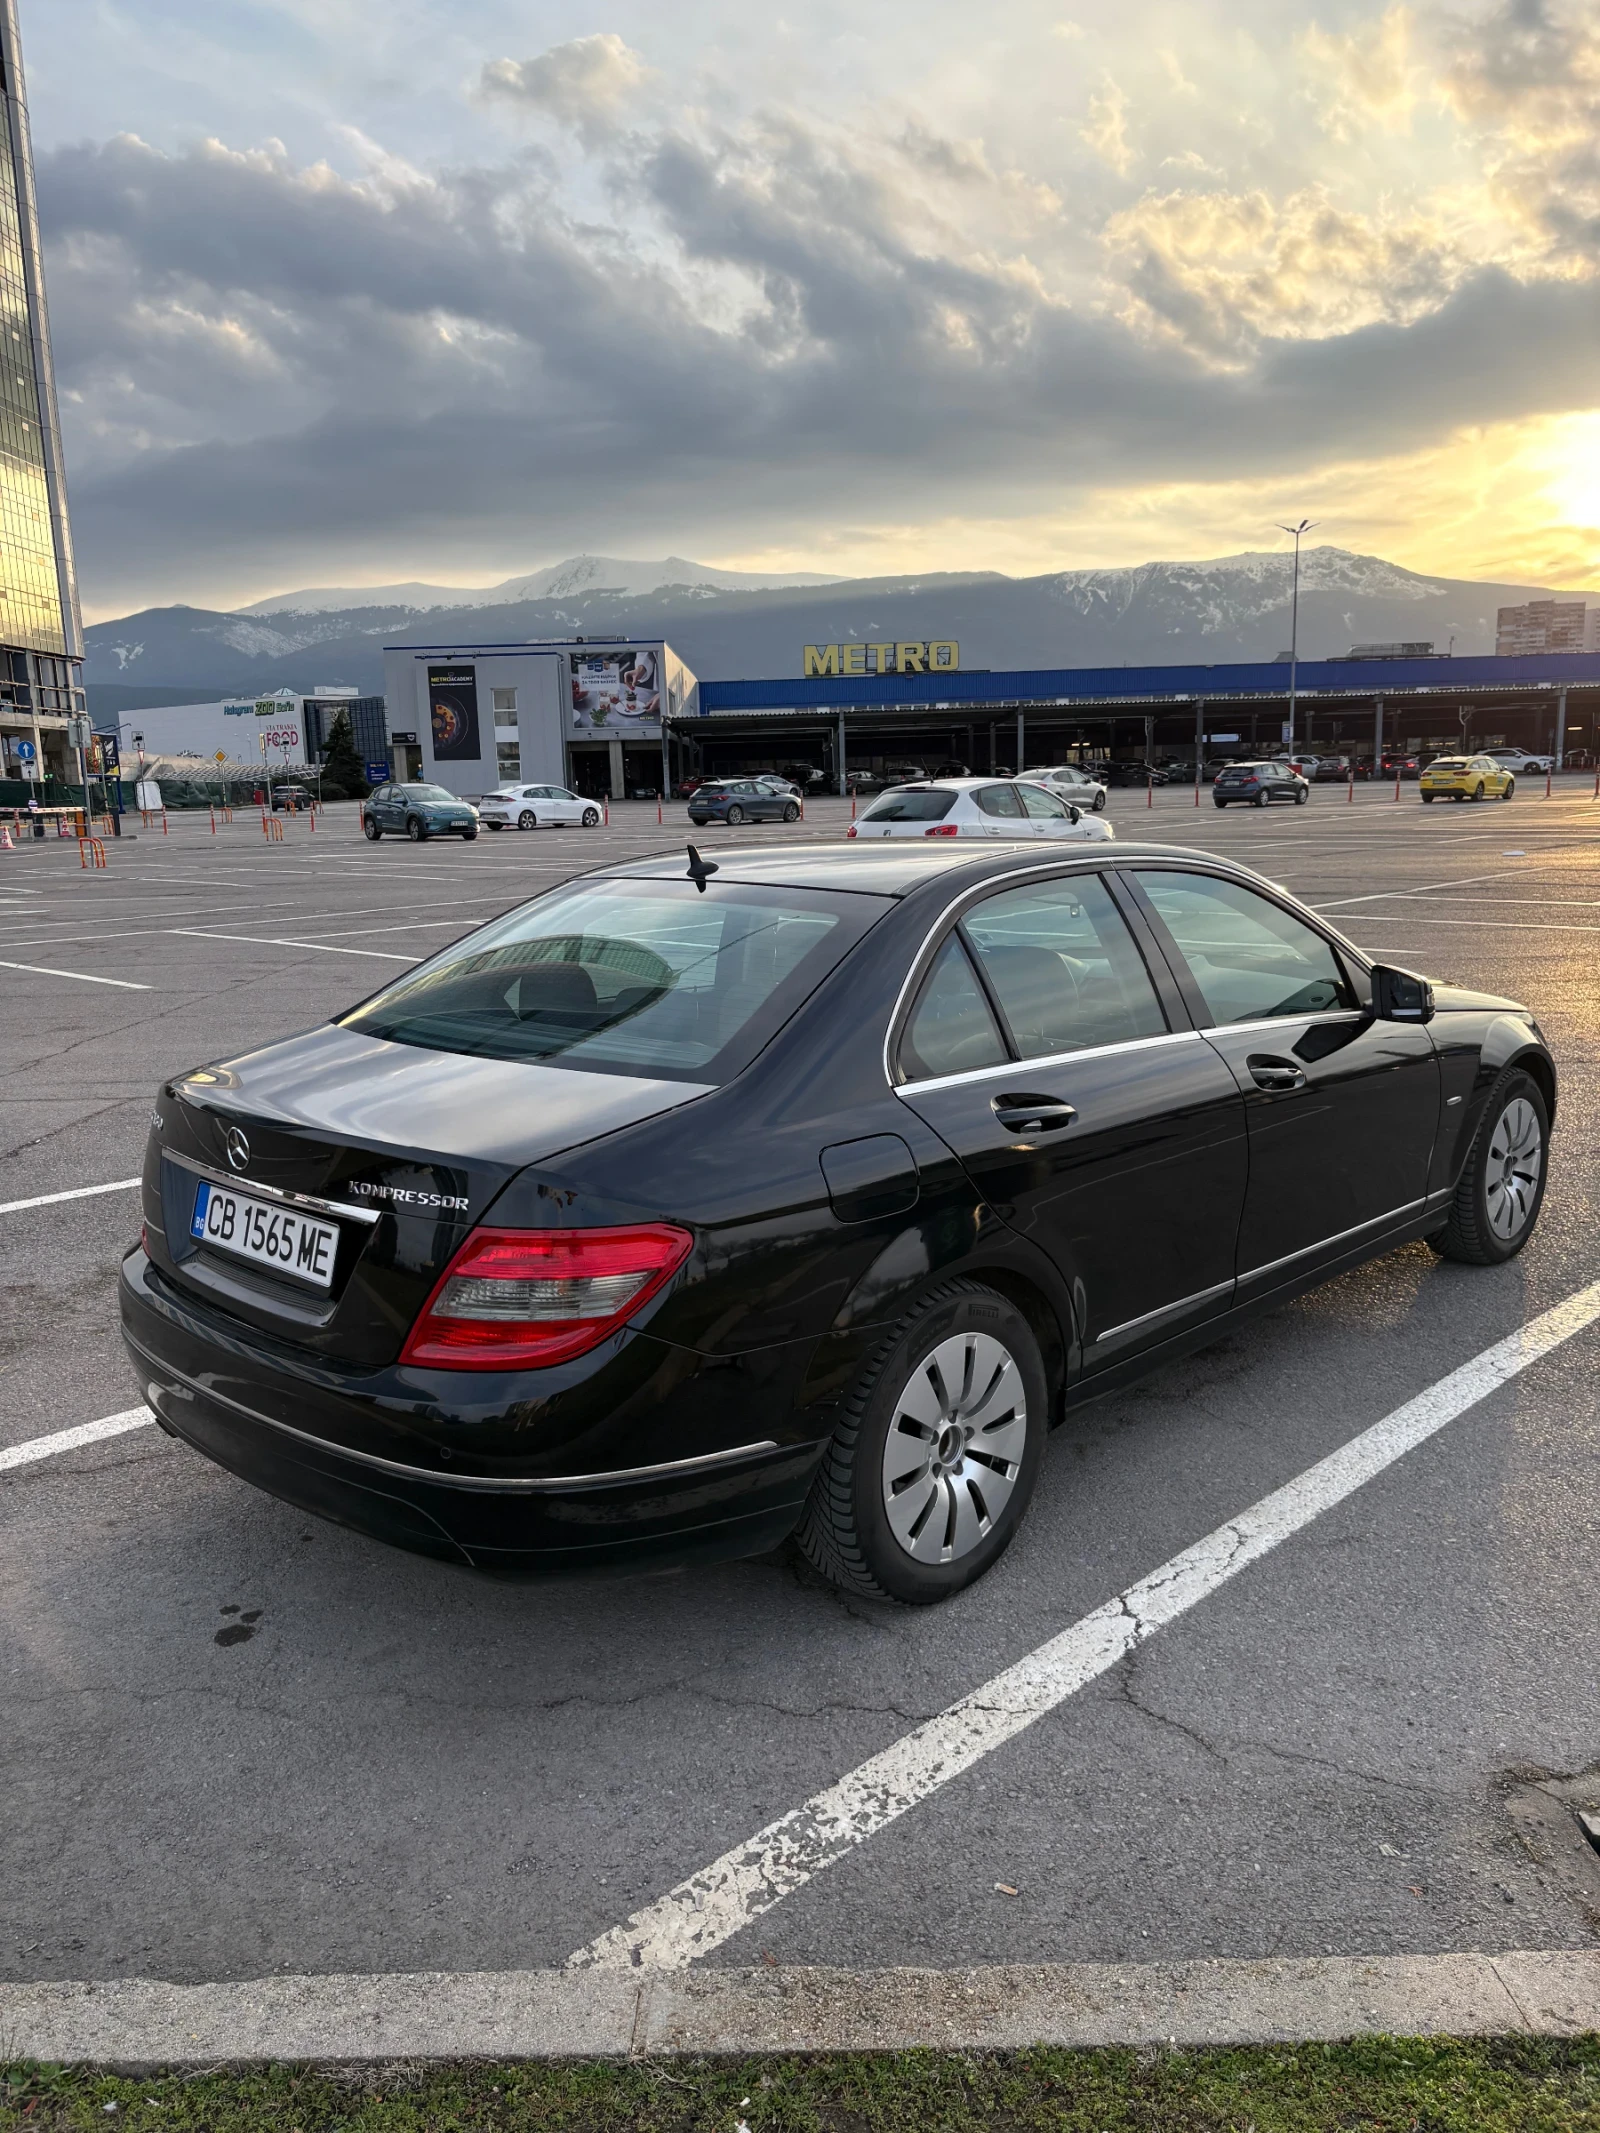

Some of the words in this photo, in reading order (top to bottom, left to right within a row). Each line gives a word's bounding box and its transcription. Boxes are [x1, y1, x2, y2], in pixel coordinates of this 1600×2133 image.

[804, 640, 960, 676] METRO
[255, 701, 275, 716] ZOO
[348, 1180, 470, 1211] KOMPRESSOR
[195, 1216, 205, 1230] BG
[208, 1195, 236, 1240] CB
[243, 1205, 296, 1262] 1565
[296, 1223, 333, 1278] ME
[968, 1304, 999, 1318] PIRELLI
